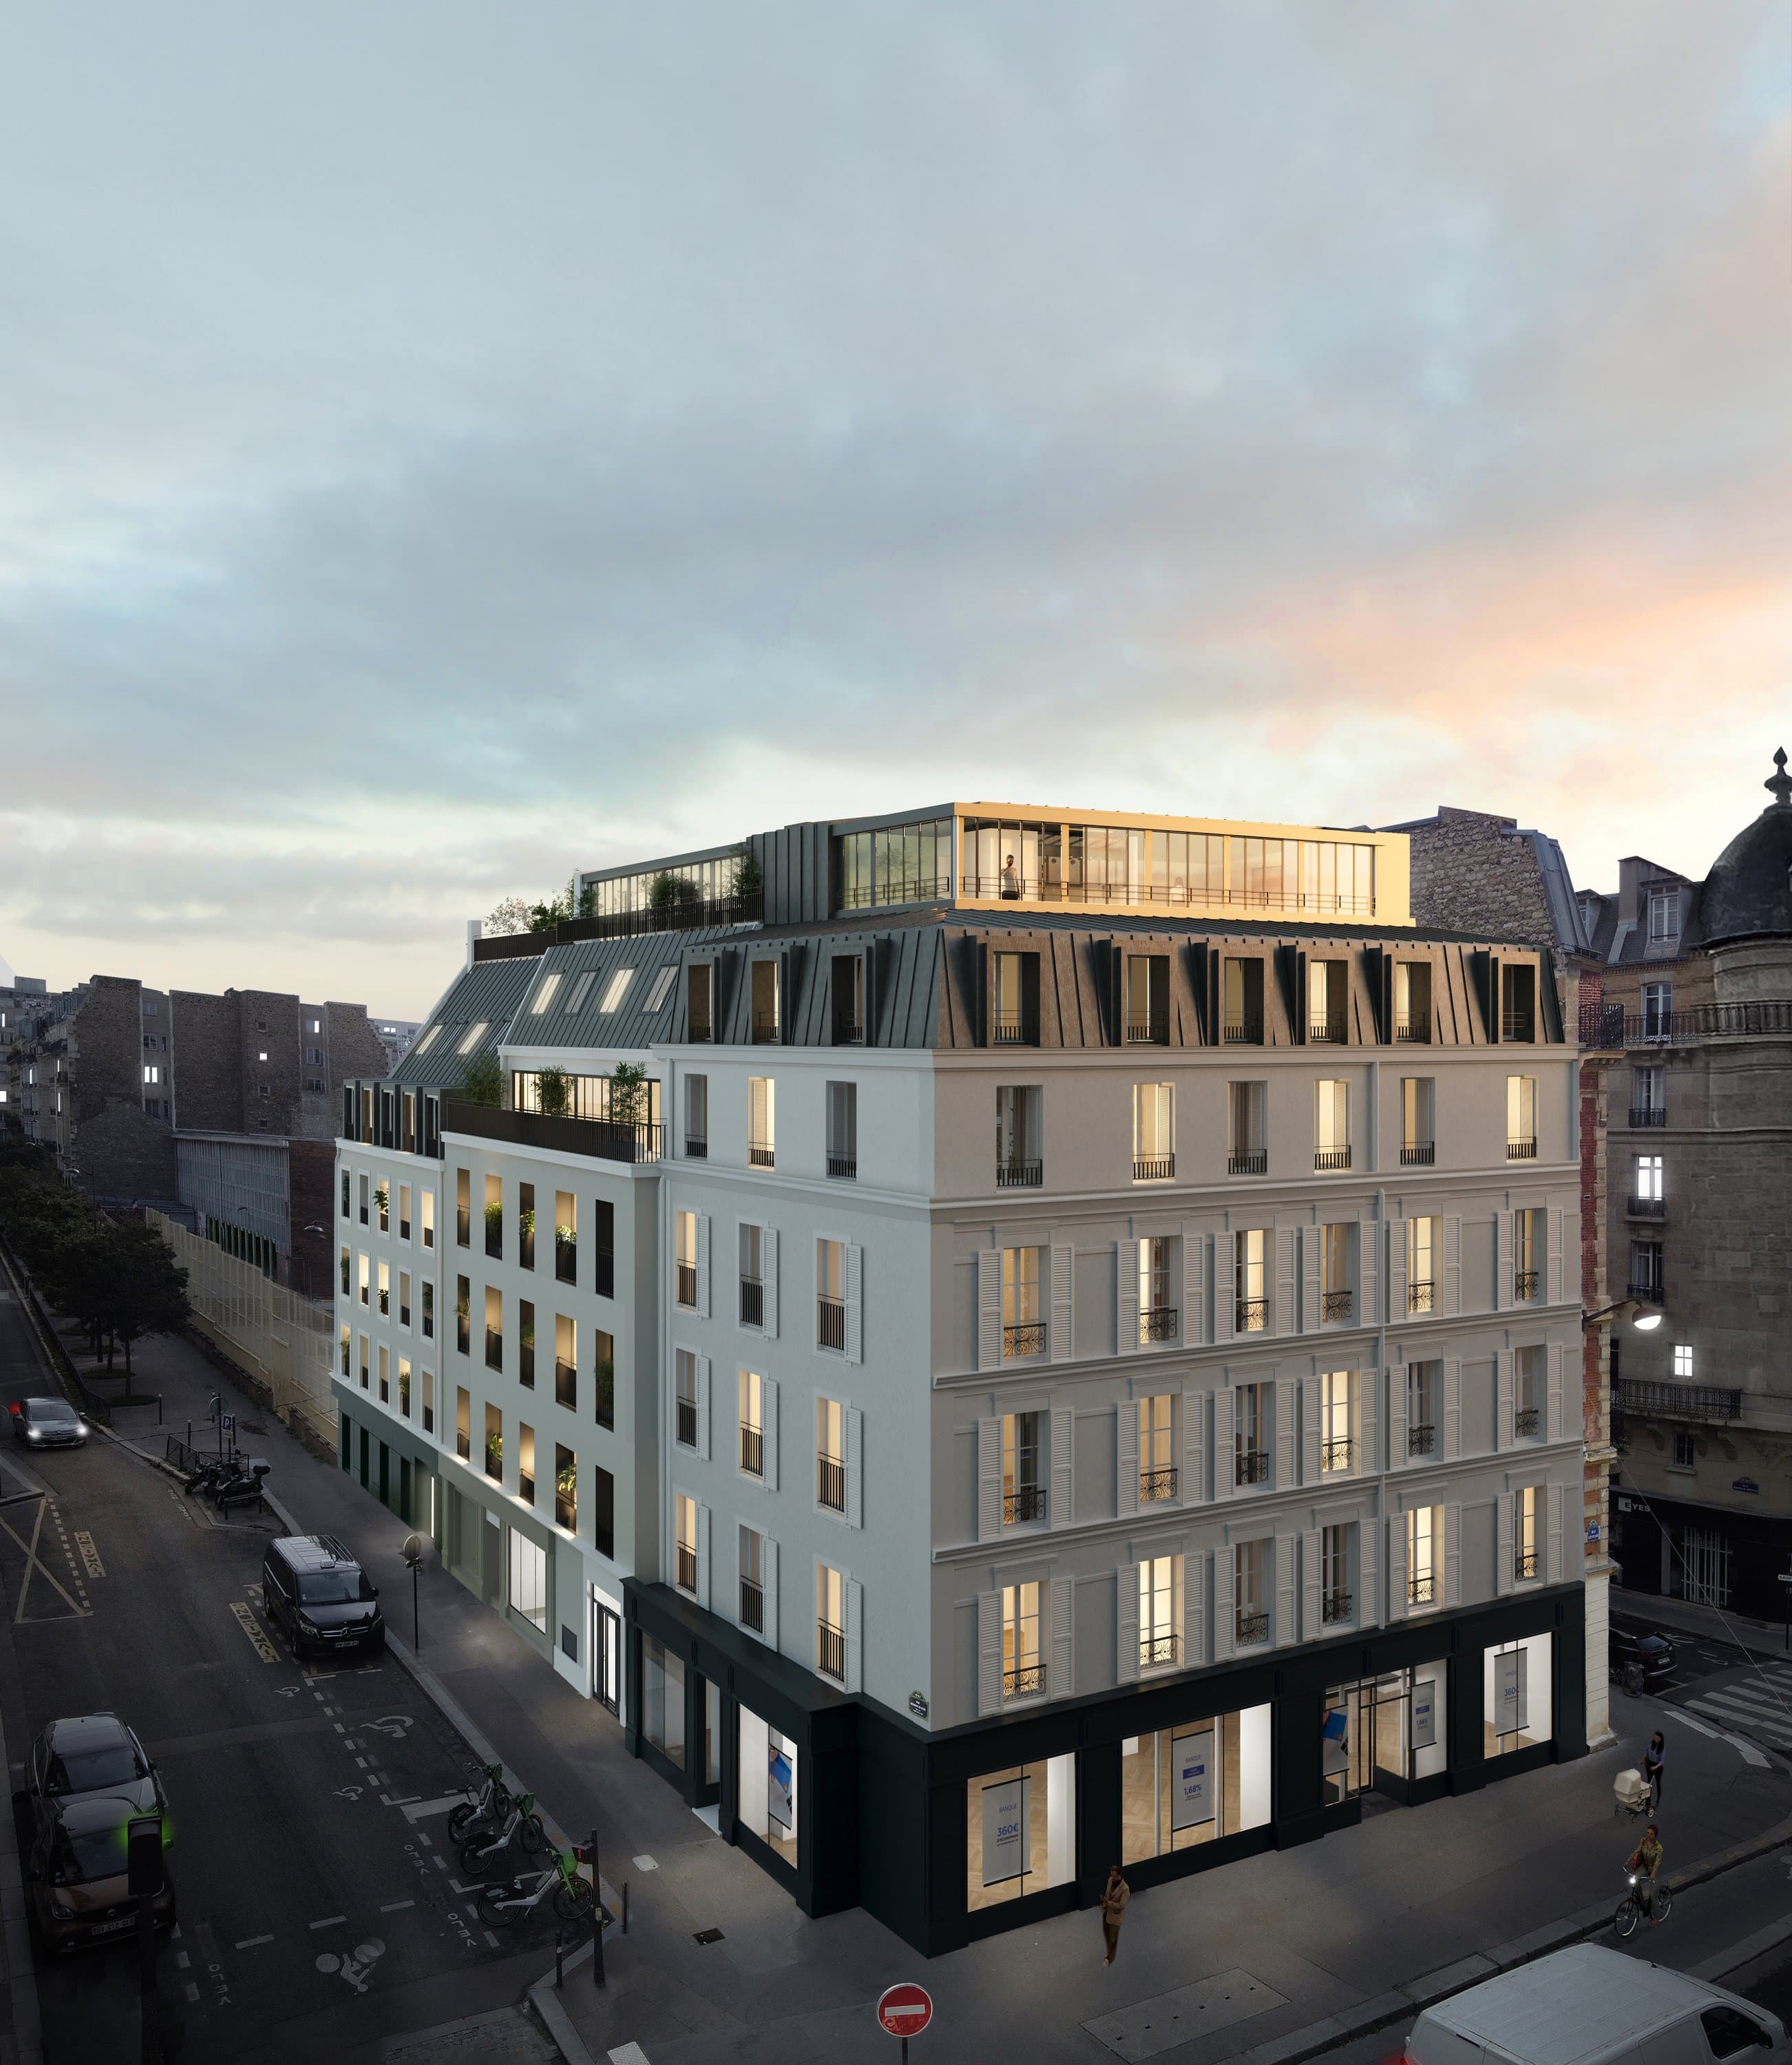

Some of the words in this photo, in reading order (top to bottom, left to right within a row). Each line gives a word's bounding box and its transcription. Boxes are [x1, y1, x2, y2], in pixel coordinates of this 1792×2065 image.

[1625, 1502, 1650, 1512] EYES
[1184, 1784, 1202, 1796] 1,68%
[999, 1803, 1018, 1813] BANQUE
[997, 1823, 1019, 1837] 360€
